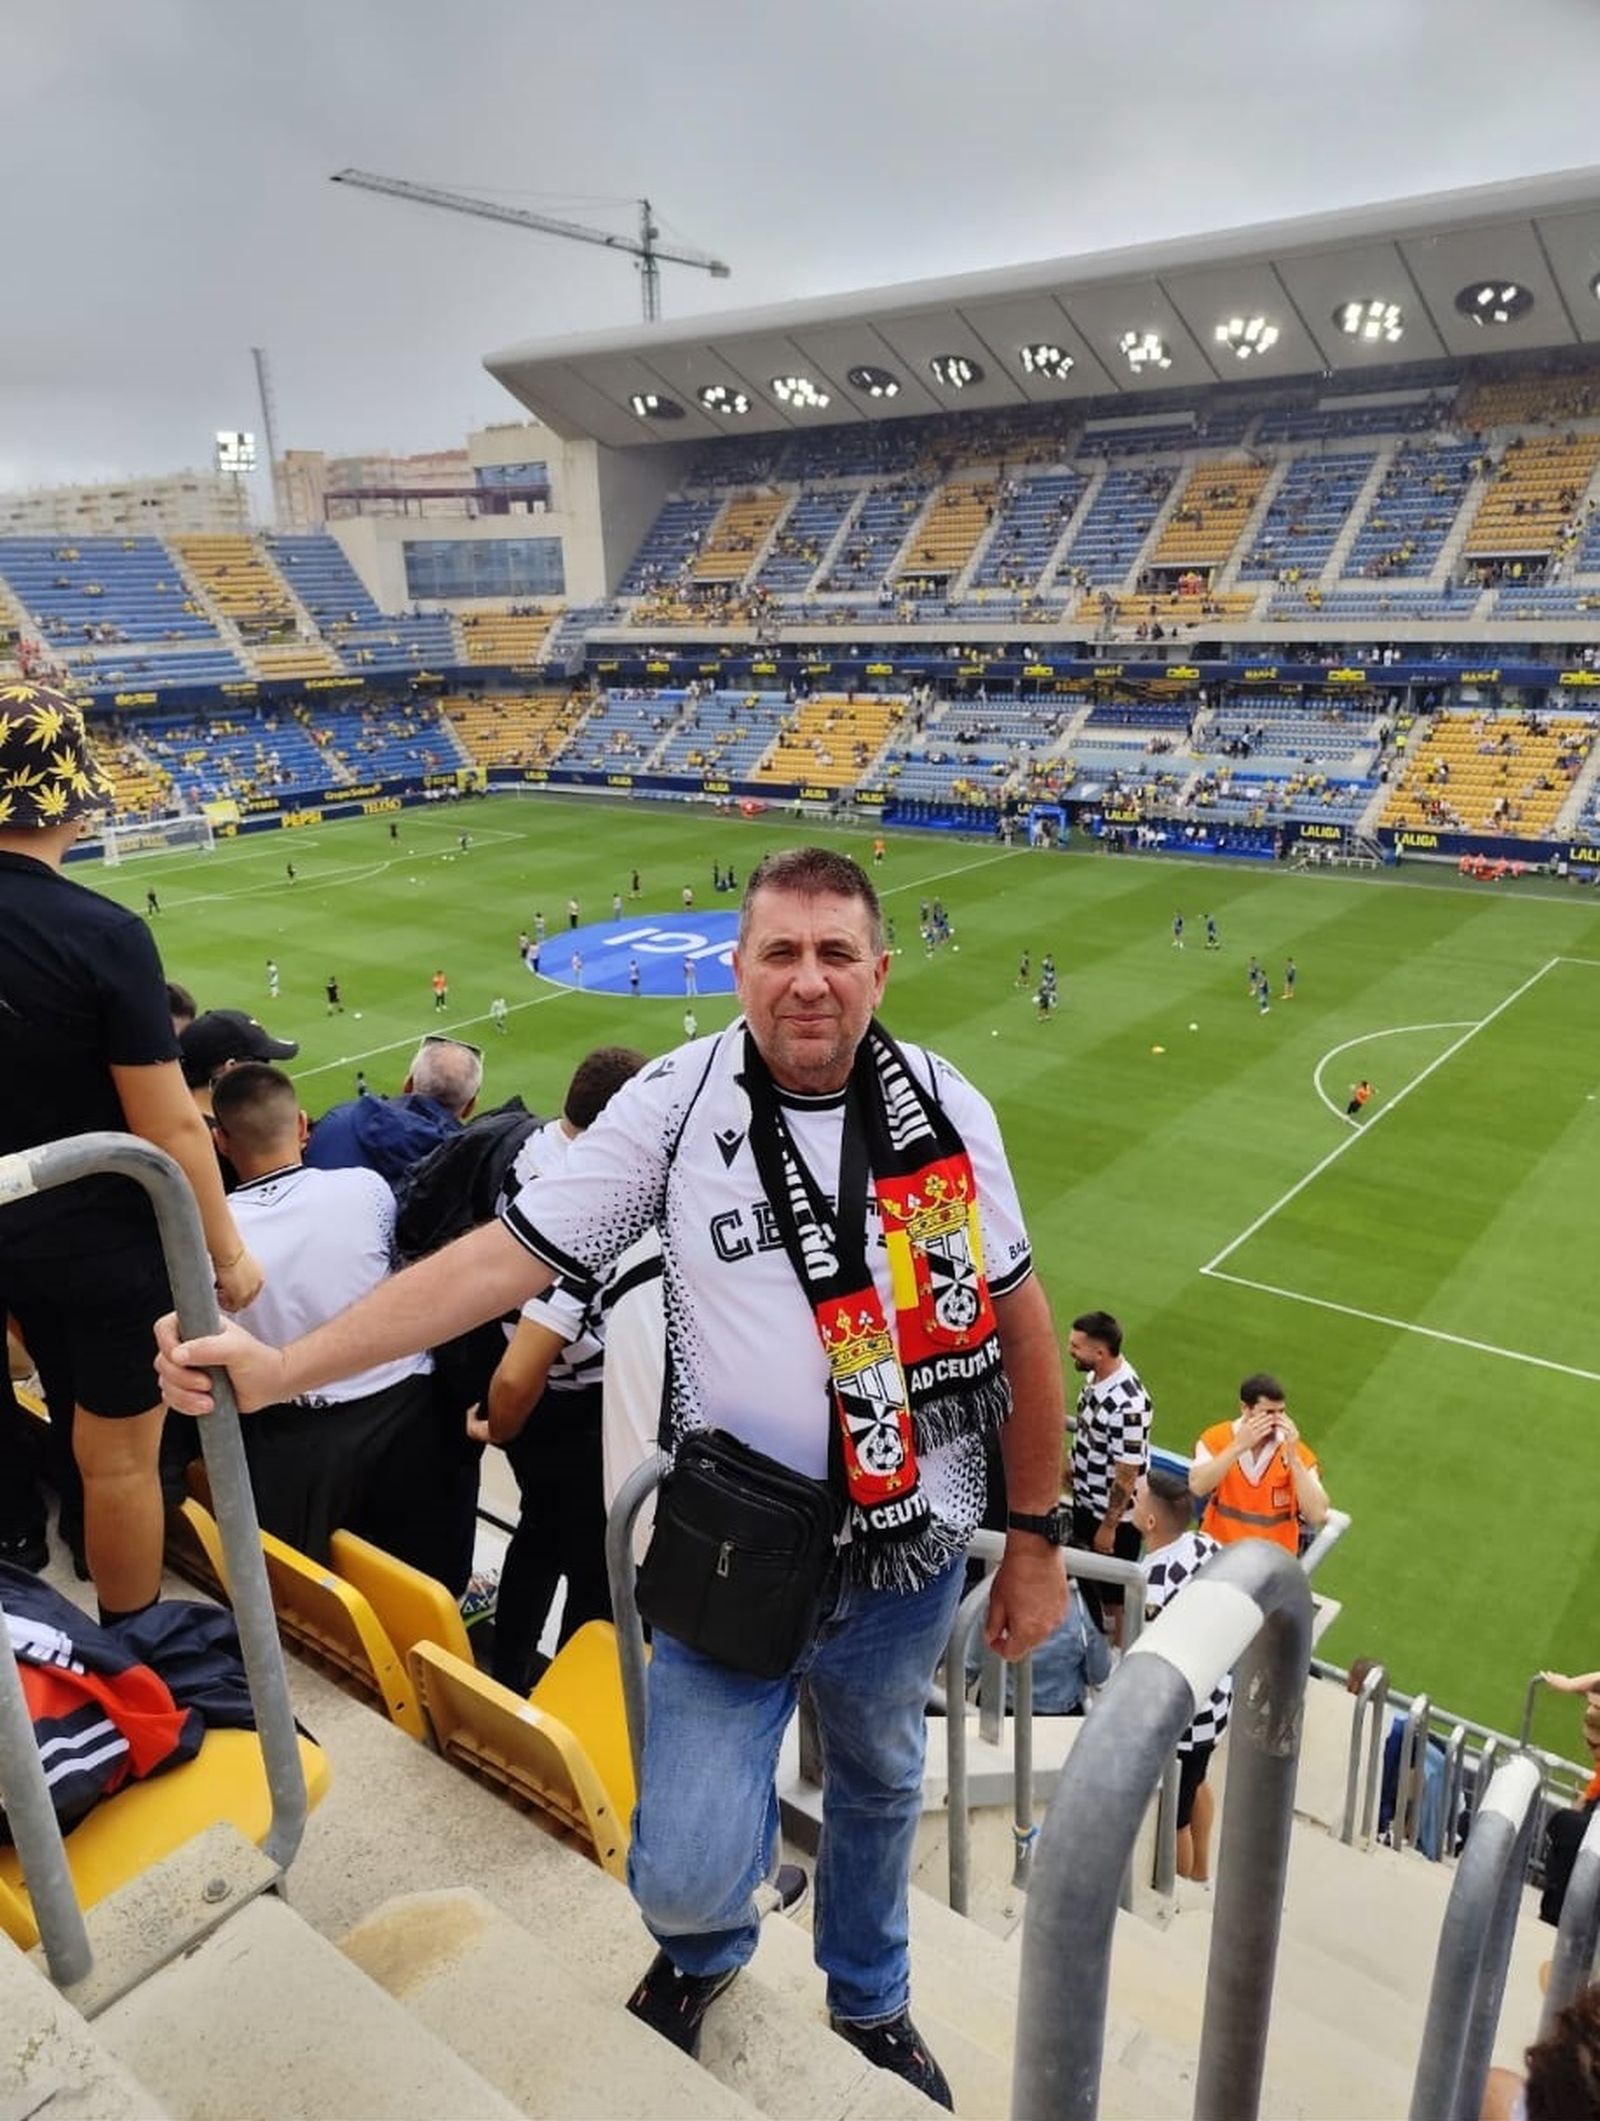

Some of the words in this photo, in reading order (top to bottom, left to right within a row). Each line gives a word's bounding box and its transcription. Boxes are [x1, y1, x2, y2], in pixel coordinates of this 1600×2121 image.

[1301, 825, 1341, 839] LALIGA
[1394, 832, 1437, 848] LALIGA
[911, 1366, 935, 1393] AD
[936, 1349, 988, 1381] CEUTA
